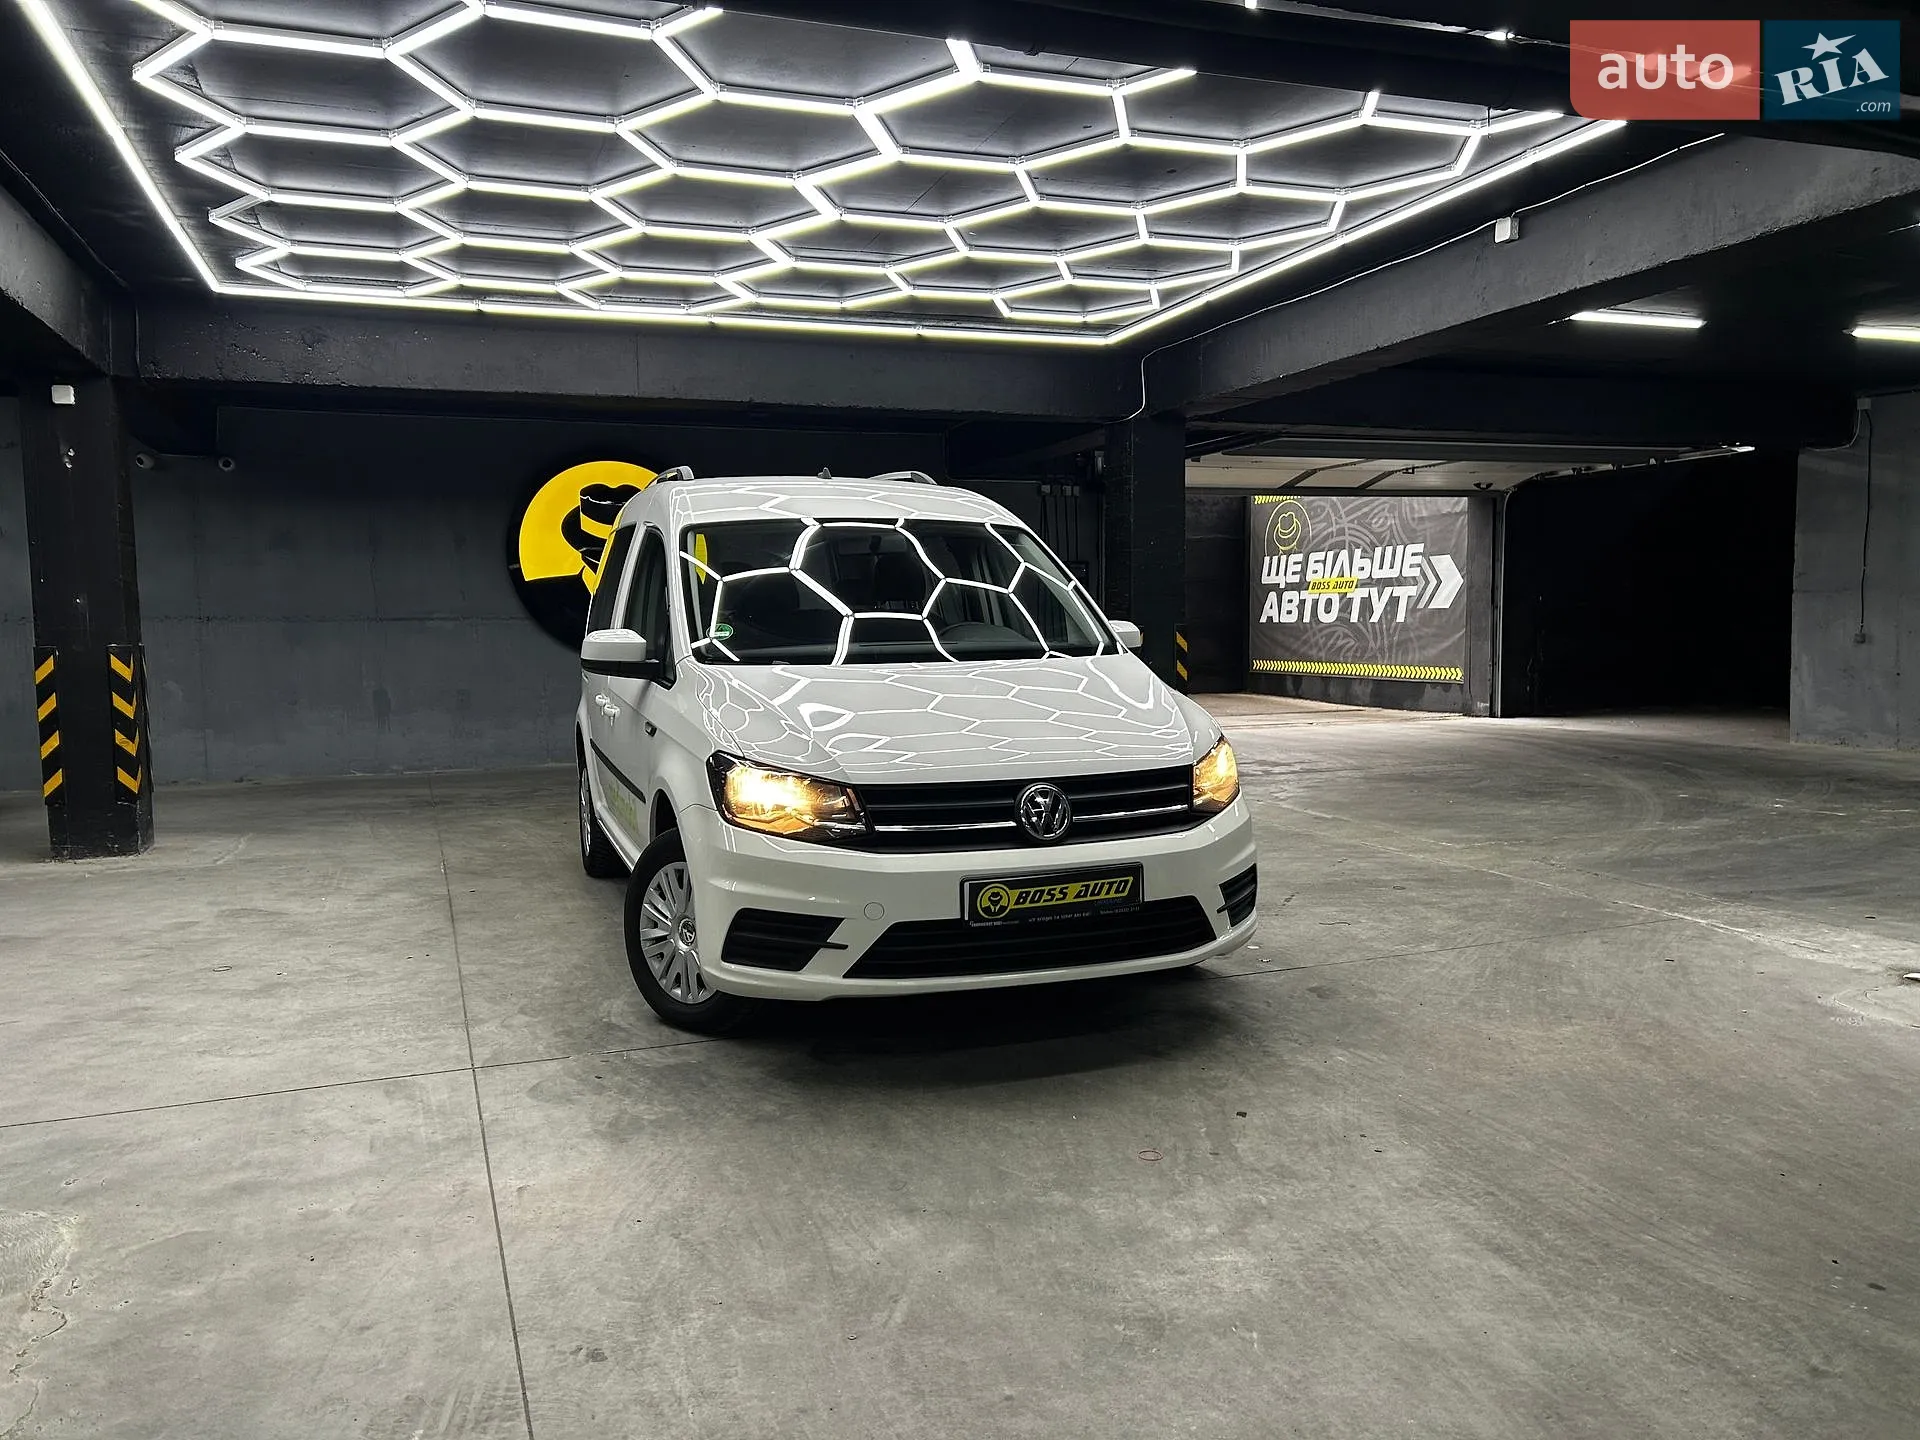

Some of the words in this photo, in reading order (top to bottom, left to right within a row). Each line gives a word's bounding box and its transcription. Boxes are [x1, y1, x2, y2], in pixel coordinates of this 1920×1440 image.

[1261, 554, 1303, 588] ЩЕ
[1306, 543, 1425, 582] БІЛЬШЕ
[1311, 579, 1331, 591] BOSS
[1332, 579, 1355, 590] AUTO
[1259, 590, 1341, 623] АВТО
[1347, 585, 1417, 623] ТУТ
[1013, 886, 1070, 906] BOSS
[1073, 879, 1131, 900] AUTO
